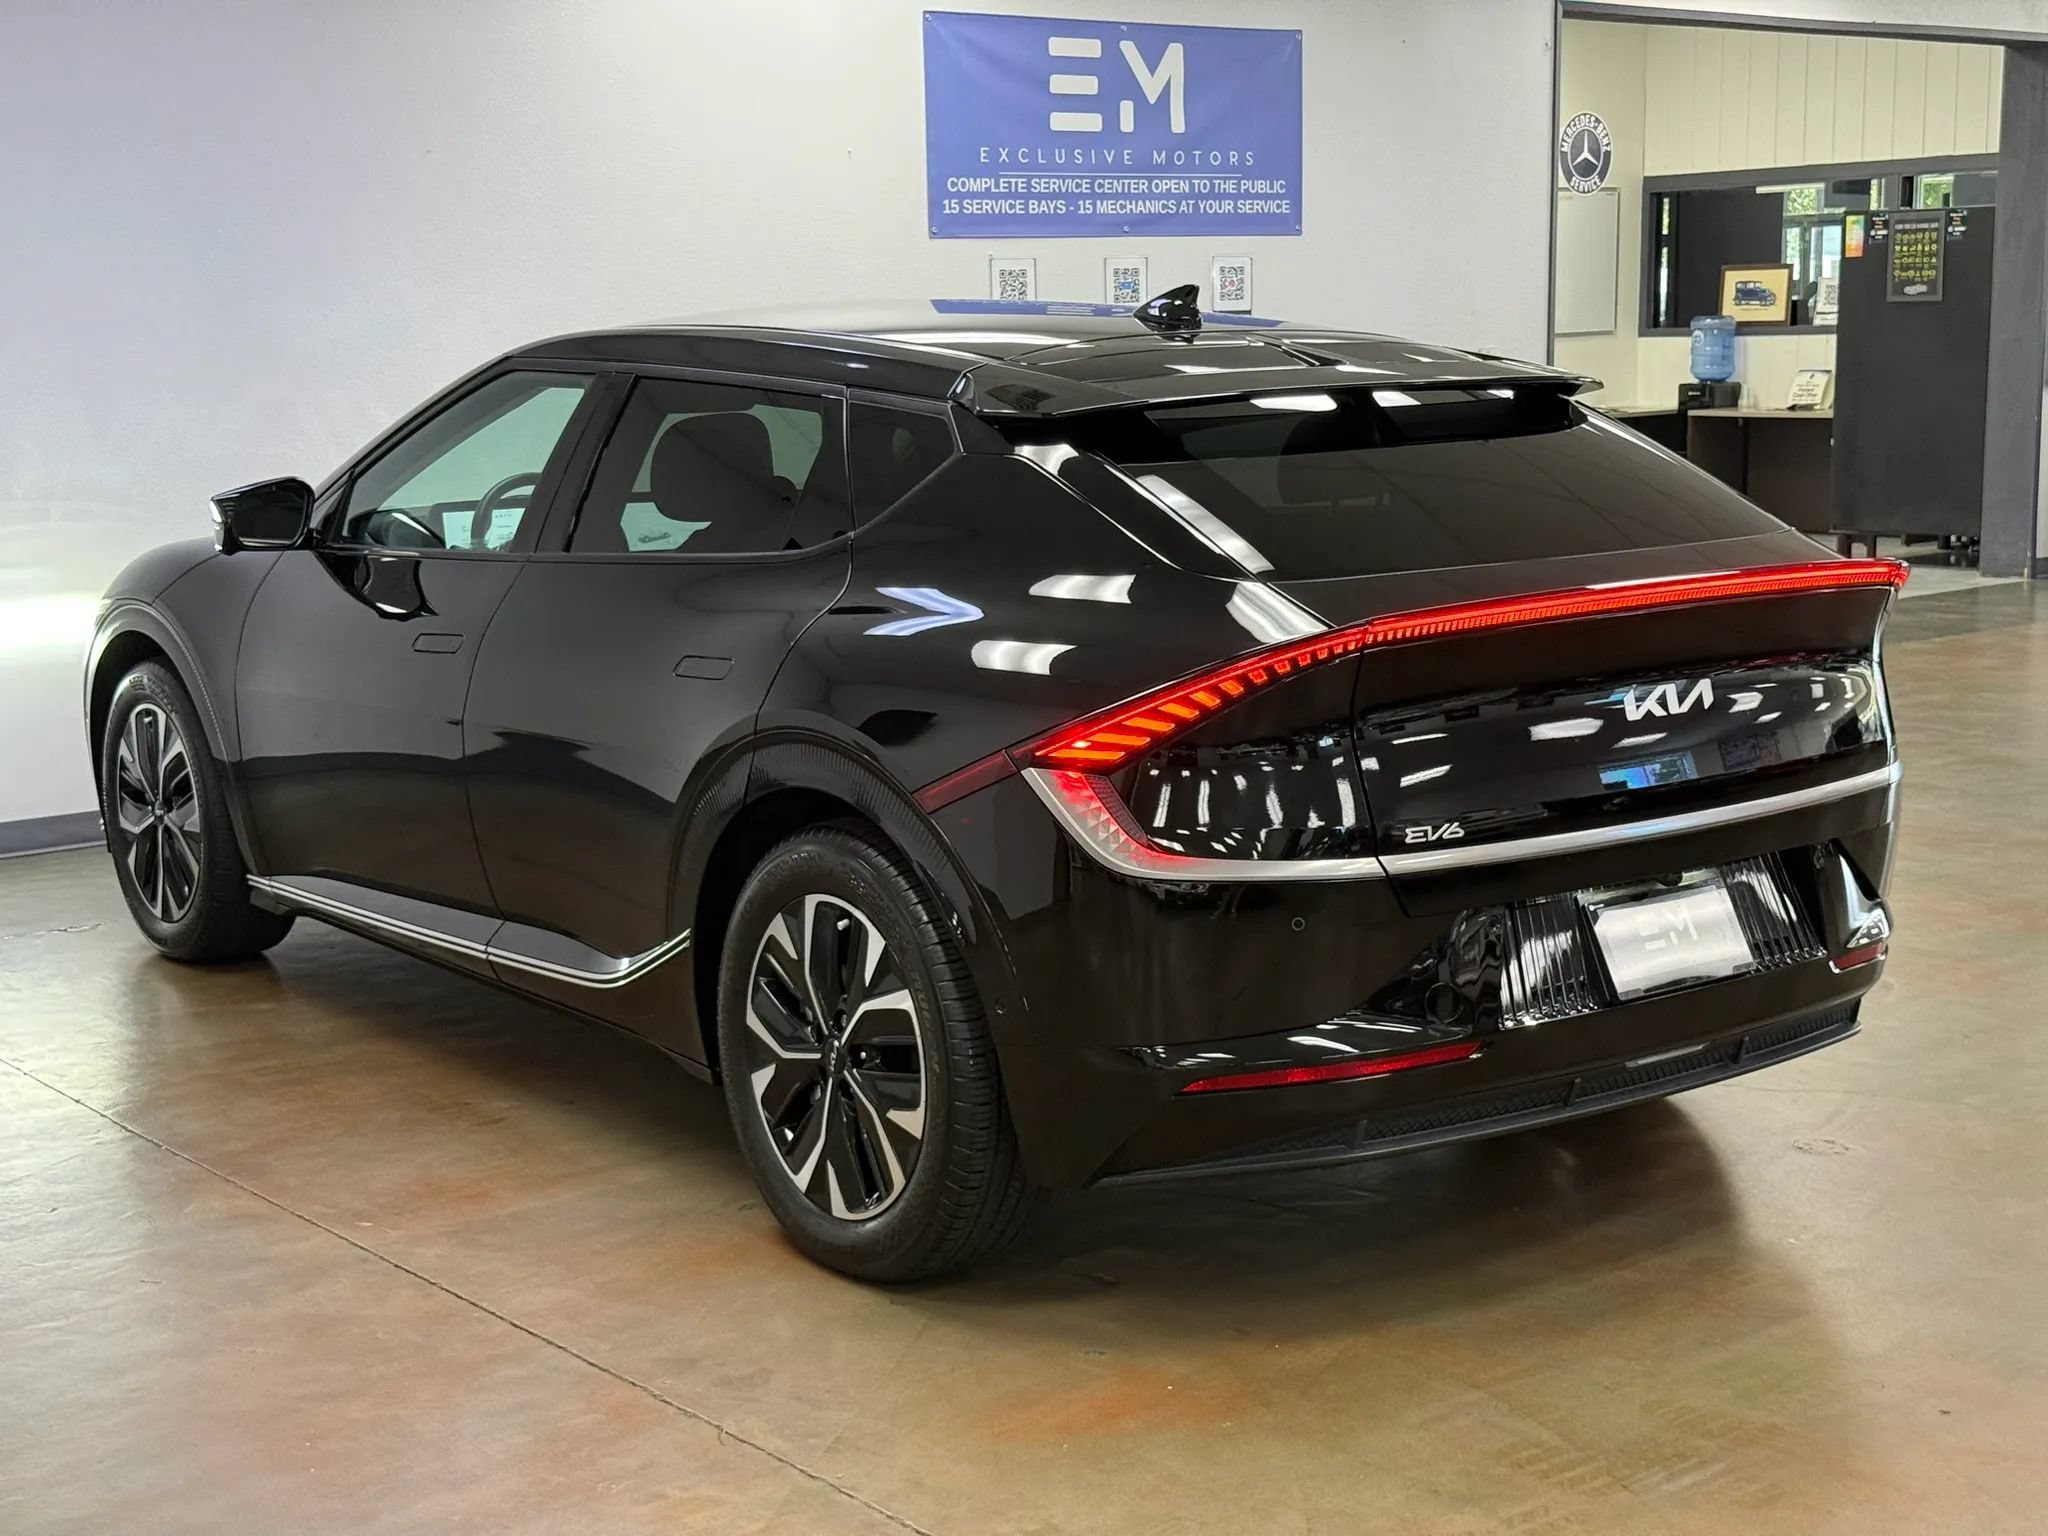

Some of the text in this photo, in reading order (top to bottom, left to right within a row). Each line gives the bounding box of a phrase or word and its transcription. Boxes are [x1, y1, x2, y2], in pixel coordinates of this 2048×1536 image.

[1048, 36, 1186, 134] EM
[1560, 114, 1611, 152] MERCEDES-BENZ
[980, 147, 1254, 166] EXCLUSIVE MOTORS
[947, 177, 1286, 194] COMPLETE SERVICE CENTER OPEN TO THE PUBLIC
[1569, 175, 1601, 193] SERVICE
[942, 199, 960, 214] 15
[962, 199, 1025, 214] SERVICE
[1028, 199, 1066, 214] BAYS
[1077, 200, 1093, 214] 15
[1096, 199, 1177, 214] MECHANICS
[1179, 200, 1195, 214] AT
[1198, 200, 1234, 214] YOUR
[1237, 200, 1291, 214] SERVICE
[1623, 678, 1714, 721] KIA
[1404, 821, 1465, 844] EV6
